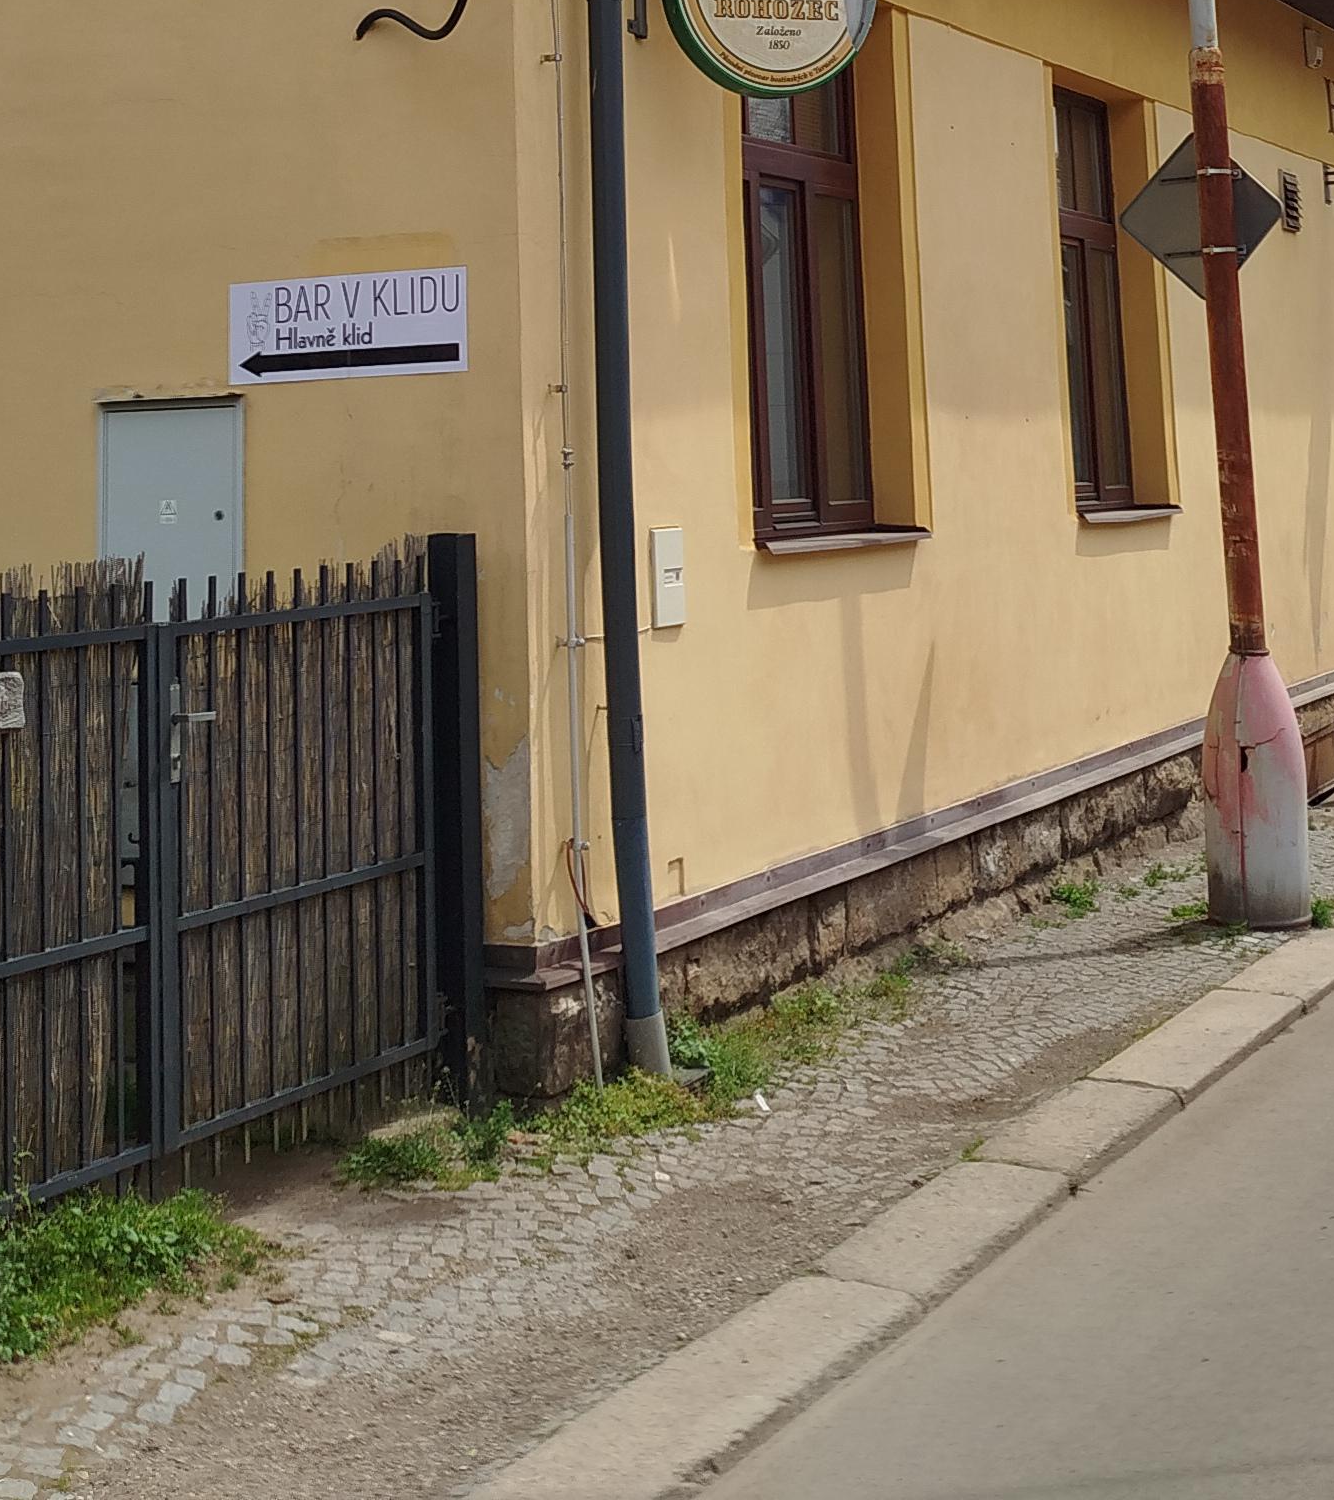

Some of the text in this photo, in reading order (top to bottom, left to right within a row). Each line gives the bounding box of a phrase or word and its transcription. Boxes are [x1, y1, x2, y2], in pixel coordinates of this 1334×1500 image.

[756, 26, 802, 37] Založeno
[768, 40, 791, 50] 1850
[274, 274, 460, 324] BAR V KLIDU
[275, 322, 373, 351] Hlavně klid
